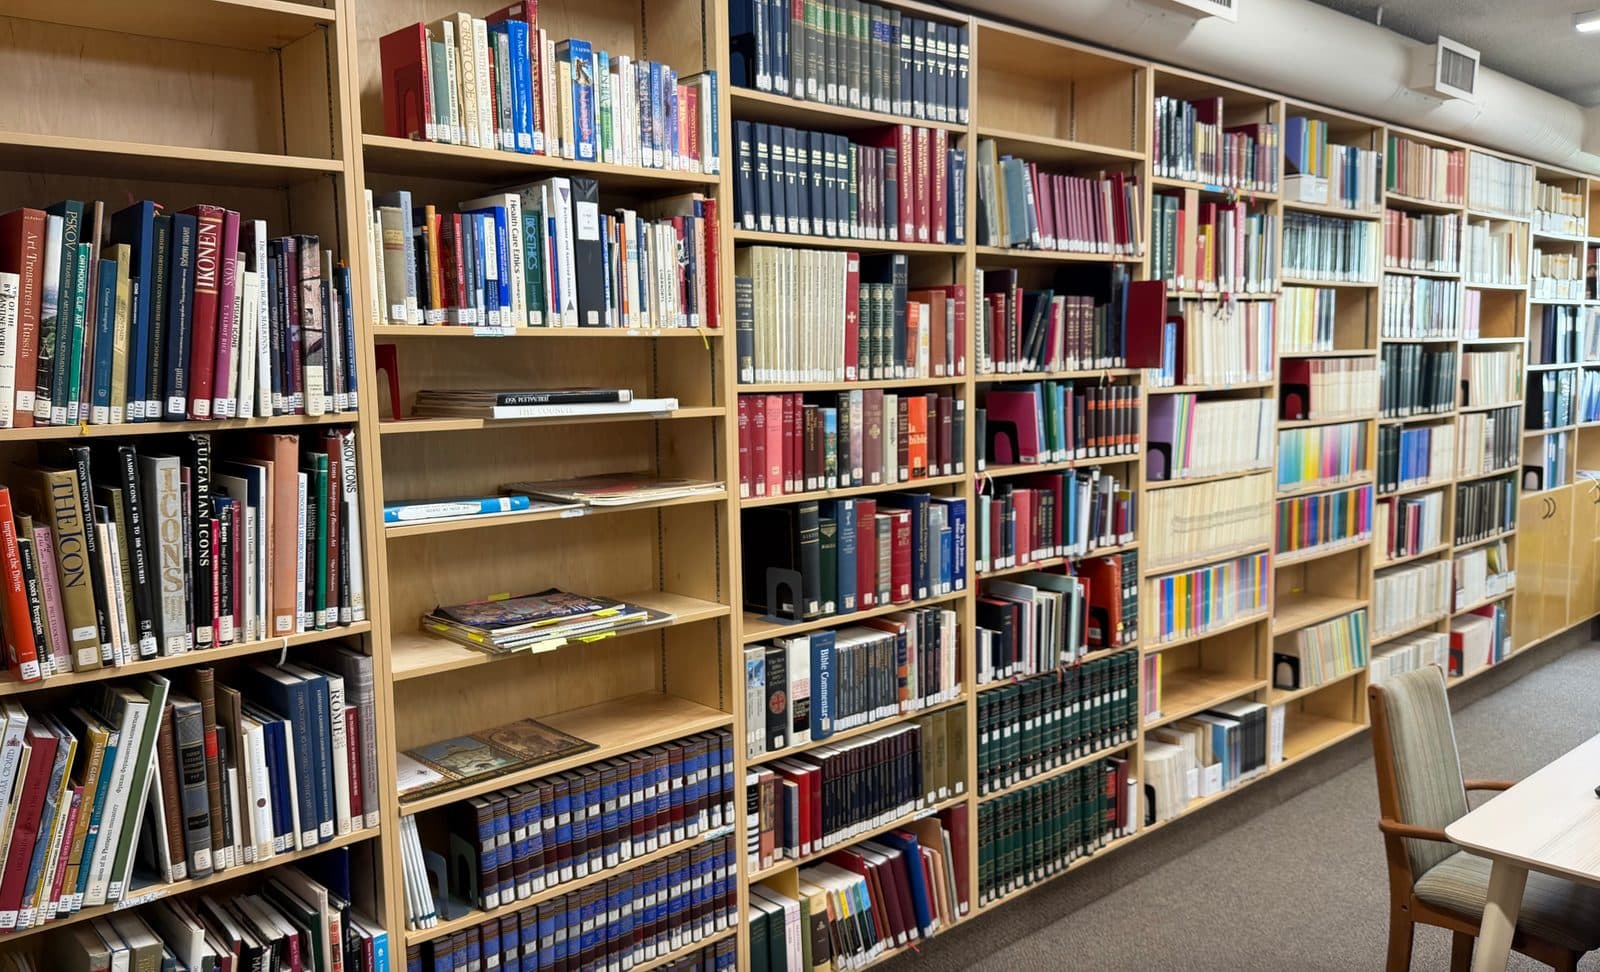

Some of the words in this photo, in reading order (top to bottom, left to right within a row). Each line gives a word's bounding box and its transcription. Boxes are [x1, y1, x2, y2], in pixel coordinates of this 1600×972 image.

[461, 20, 474, 59] GREAT
[463, 60, 476, 99] CODE
[510, 200, 519, 227] Health
[26, 232, 38, 250] Art
[64, 211, 78, 251] PSKOV
[511, 228, 519, 247] Care
[524, 216, 538, 271] BIOETHICS
[196, 222, 217, 288] IKONEN
[512, 248, 521, 274] Ethics
[23, 253, 38, 305] Treasures
[77, 254, 86, 293] ORTHODOX
[223, 257, 235, 288] ICONS
[8, 302, 15, 312] OF
[104, 287, 112, 307] Christian
[233, 295, 241, 325] RUSSIAN
[259, 291, 267, 314] BLACK
[23, 308, 34, 320] of
[74, 314, 82, 328] ART
[221, 312, 229, 337] TALBOT
[21, 322, 36, 358] Russia
[231, 327, 239, 348] ICONS
[260, 315, 268, 355] MADONNA
[342, 438, 354, 462] SKOV
[78, 461, 86, 481] ICONS
[126, 454, 136, 481] FAMOUS
[196, 438, 210, 519] BULGARIAN
[330, 461, 338, 479] Icons
[345, 465, 357, 493] ICONS
[52, 478, 76, 530] THE
[80, 482, 90, 512] WINDOWS
[129, 482, 138, 503] ICONS
[330, 482, 338, 510] Masterpieces
[85, 513, 91, 521] TO
[131, 512, 139, 524] 12th
[133, 526, 141, 535] TO
[159, 467, 183, 593] ICONS
[2, 521, 17, 558] Imprinting
[85, 522, 96, 552] ETERNITY
[198, 523, 209, 567] ICONS
[221, 522, 229, 543] Icon
[9, 558, 20, 570] the
[60, 529, 86, 589] ICON
[136, 549, 146, 584] CENTURIES
[11, 570, 22, 593] Divine
[28, 579, 38, 597] Doors
[32, 605, 43, 635] Perception
[331, 690, 343, 736] ROME
[90, 758, 99, 766] OF
[91, 742, 102, 758] TALES
[88, 767, 98, 785] GLORY
